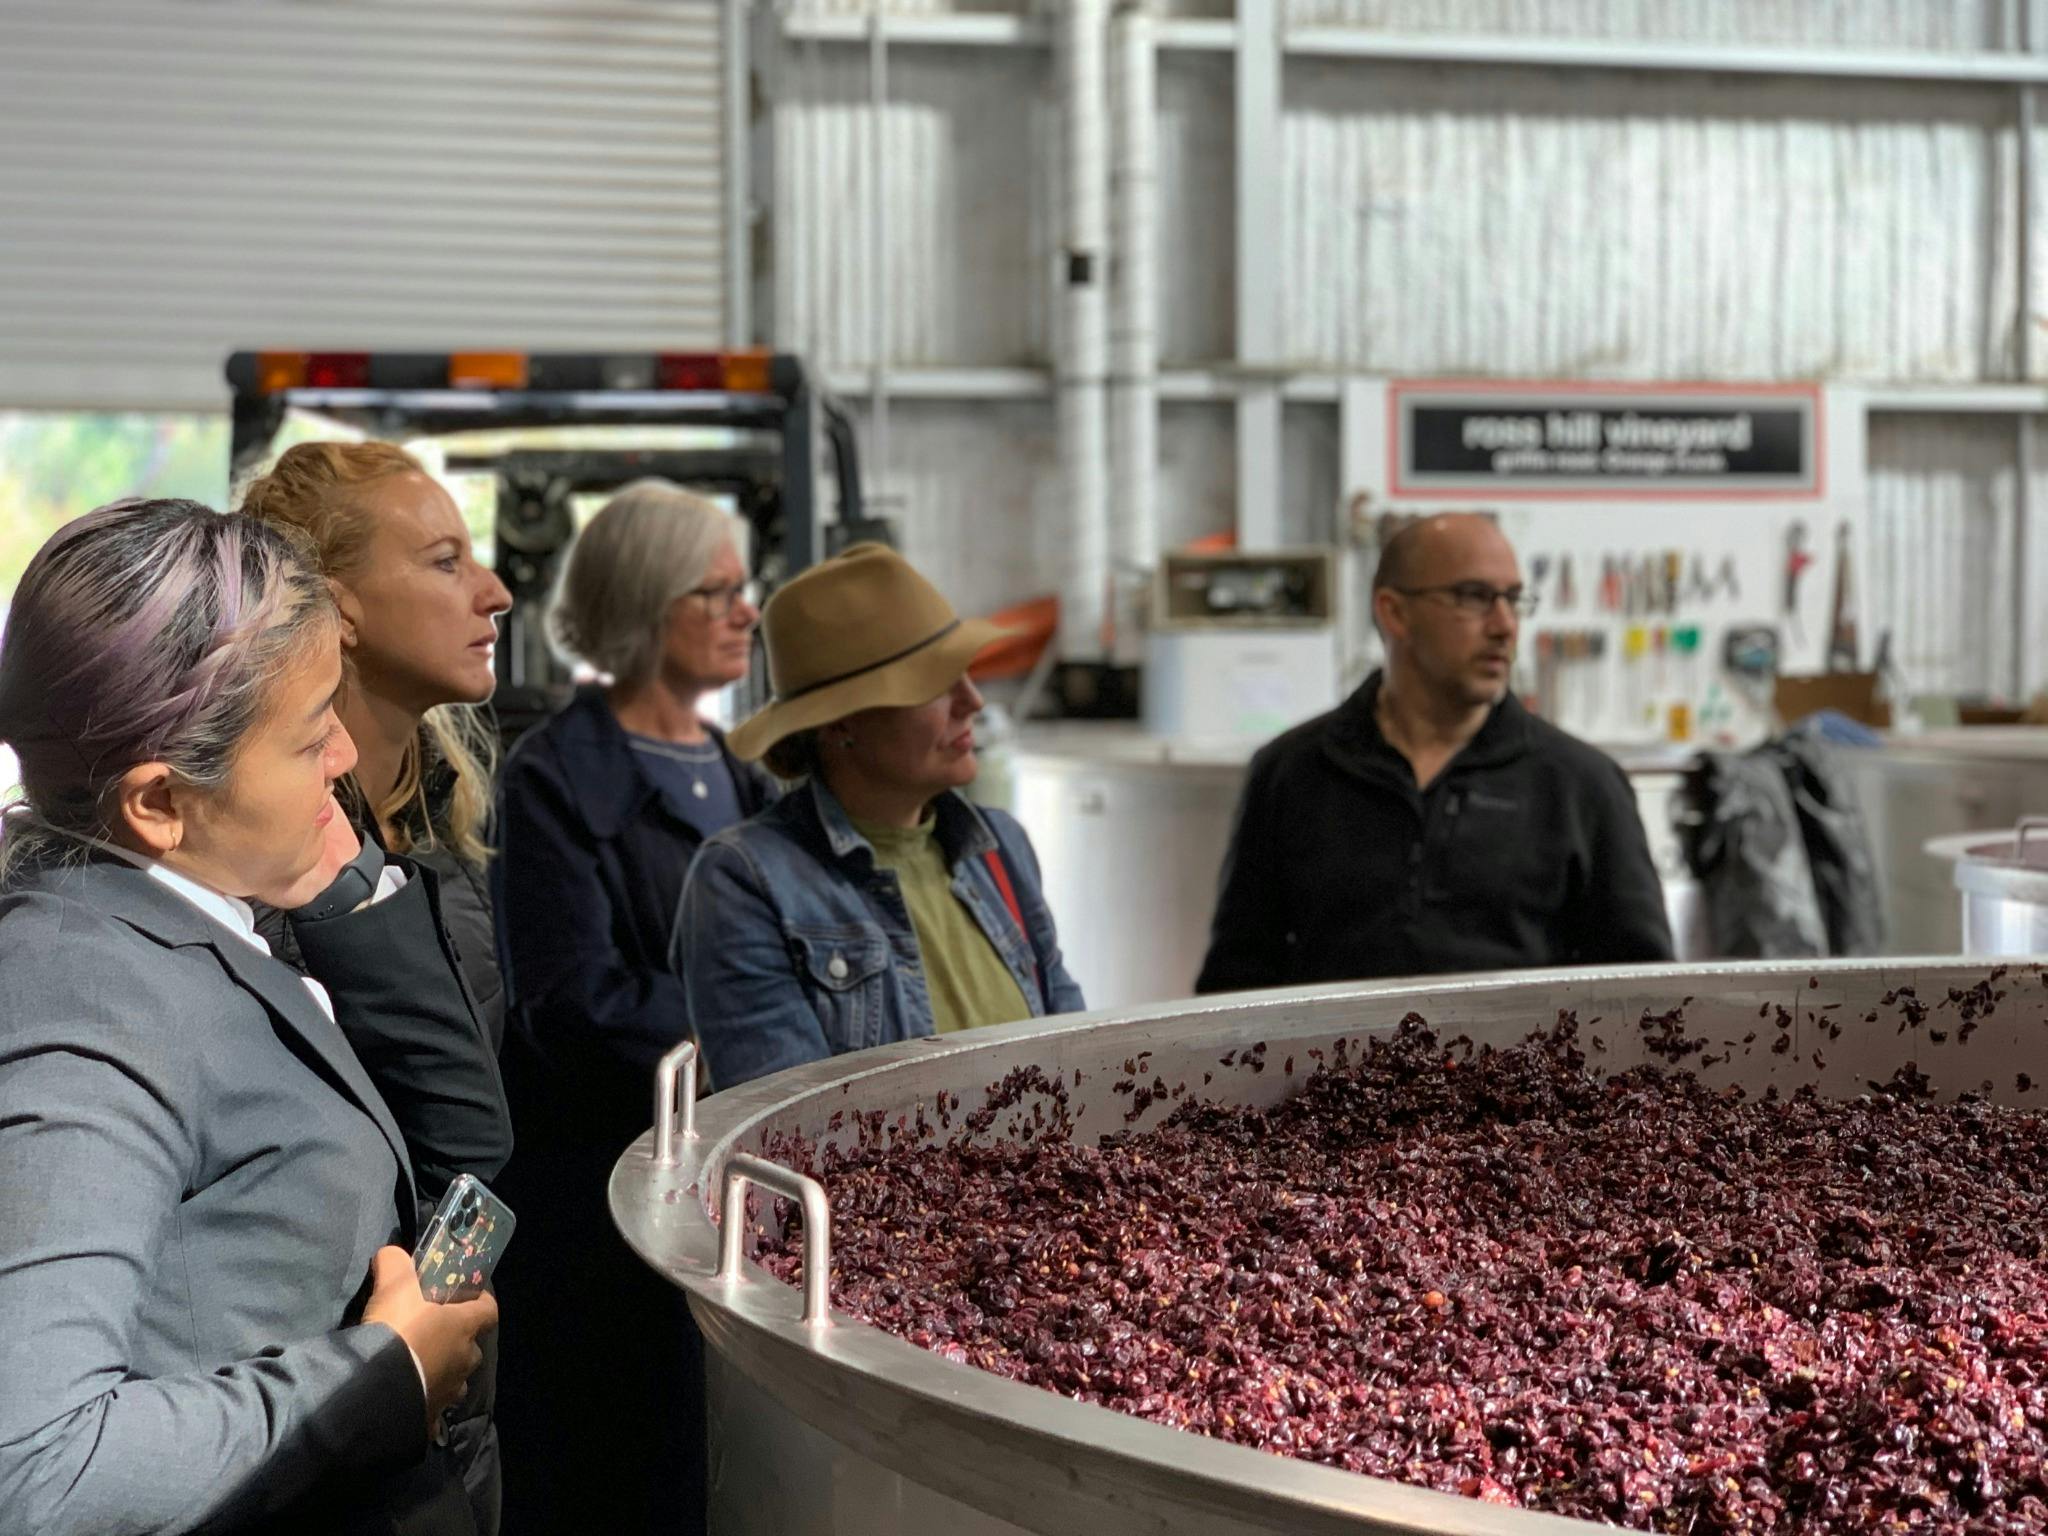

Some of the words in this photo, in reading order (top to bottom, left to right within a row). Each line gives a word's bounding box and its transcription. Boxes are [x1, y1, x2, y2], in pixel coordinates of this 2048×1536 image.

[1463, 416, 1541, 449] ross
[1546, 411, 1600, 449] hill
[1603, 411, 1752, 455] vineyard
